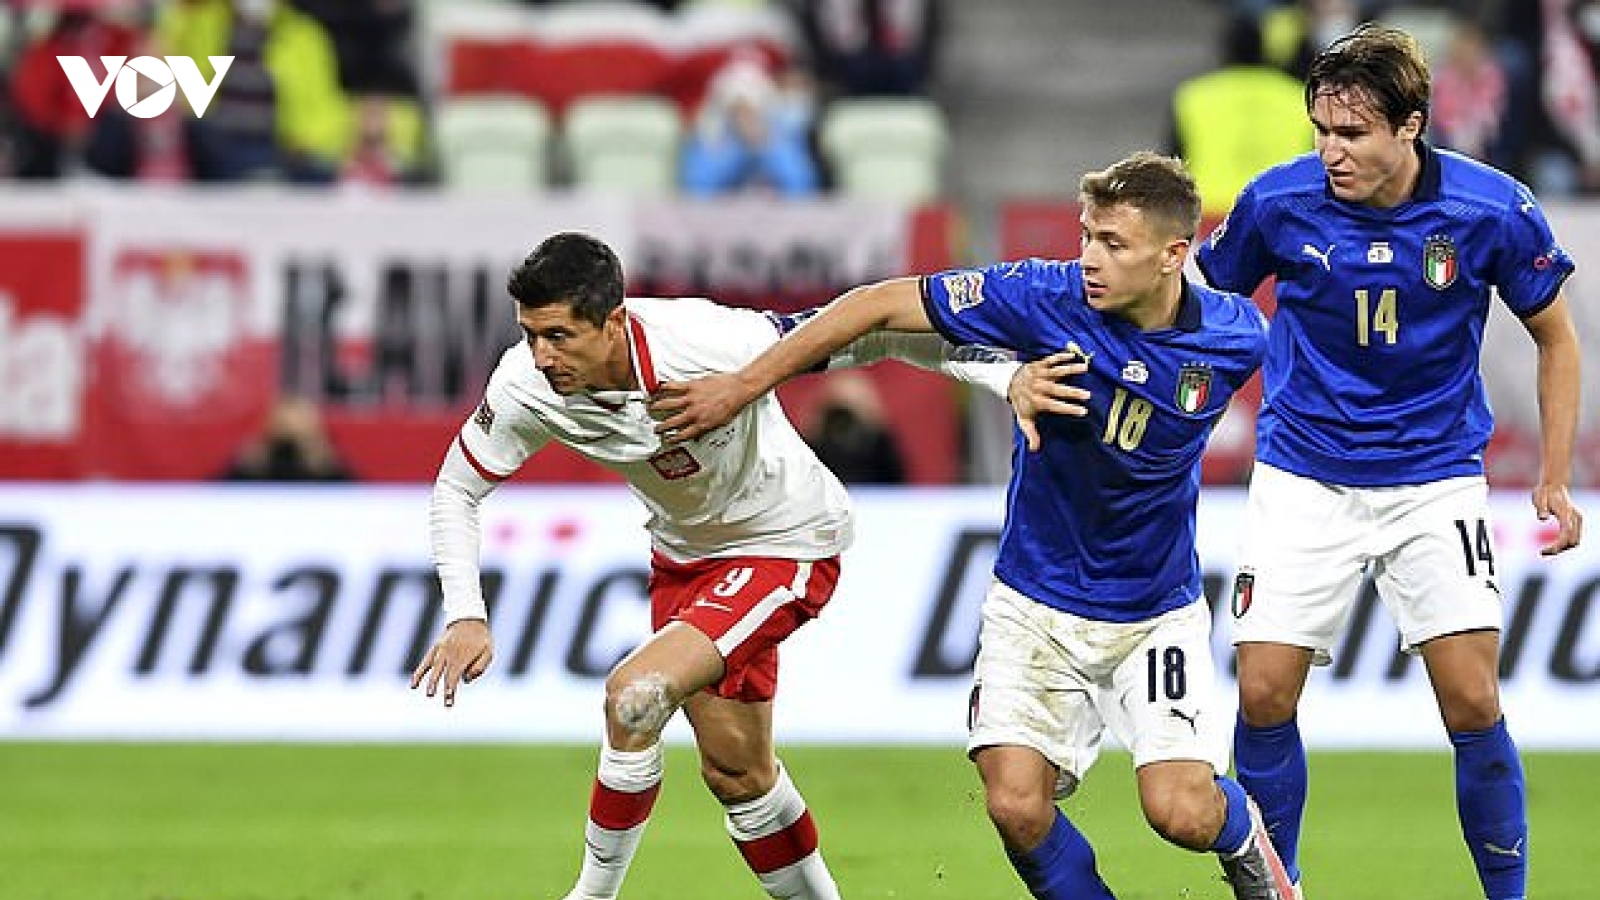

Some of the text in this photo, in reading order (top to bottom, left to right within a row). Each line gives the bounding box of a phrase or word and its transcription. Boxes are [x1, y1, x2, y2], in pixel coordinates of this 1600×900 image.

[1354, 289, 1399, 346] 14
[1102, 387, 1154, 451] 18
[1454, 518, 1495, 576] 14
[713, 567, 755, 597] 9
[1146, 646, 1187, 703] 18
